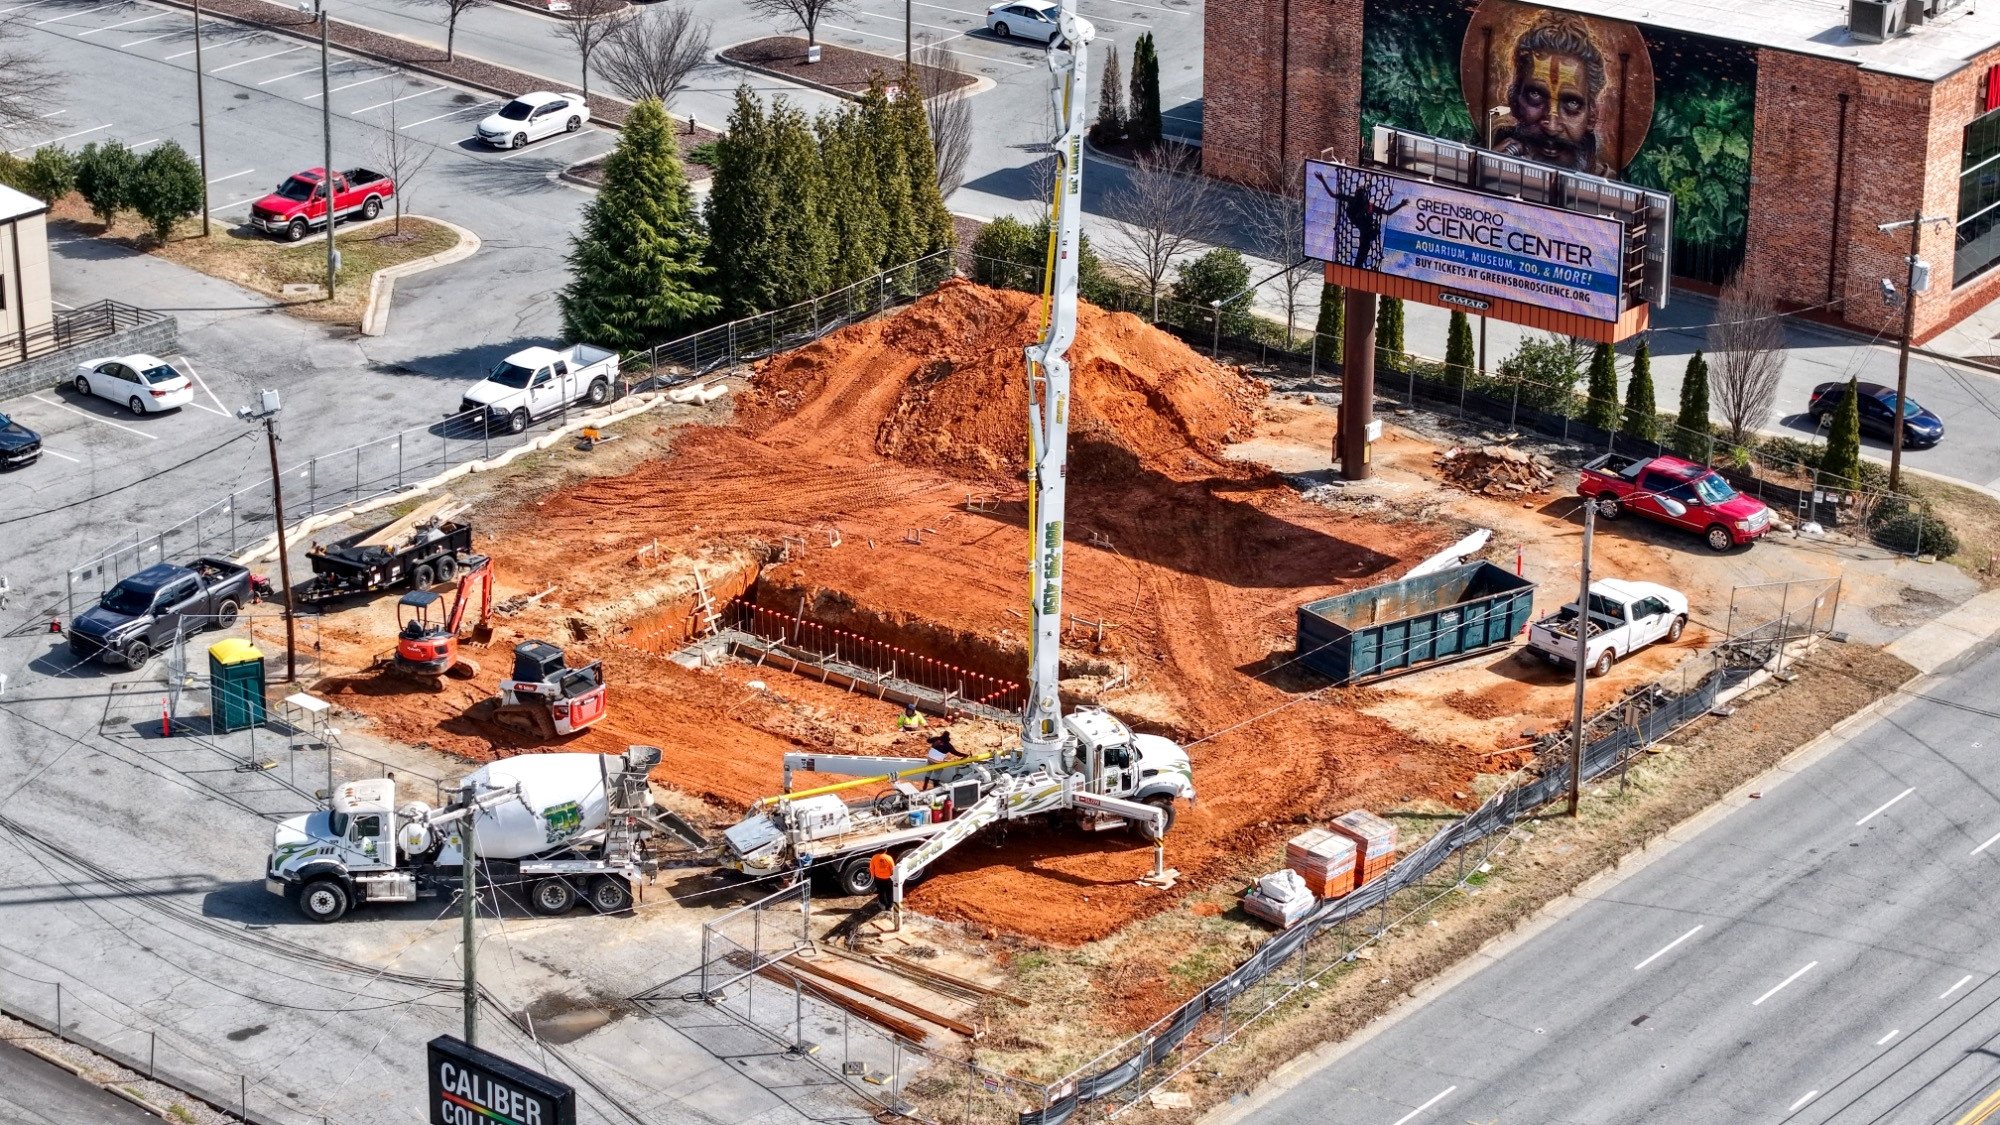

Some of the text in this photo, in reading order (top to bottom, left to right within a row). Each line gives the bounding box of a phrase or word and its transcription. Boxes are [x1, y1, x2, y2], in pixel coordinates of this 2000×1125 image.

[1416, 198, 1504, 227] GREENSBORO
[1415, 212, 1592, 267] SCIENCE CENTER
[1415, 240, 1593, 286] AQUARIUM, MUSEUM, ZOO, & MORE!
[1415, 257, 1591, 303] BUY TICKETS AT GREENSBOROSCIENCE.ORG
[1443, 294, 1484, 309] LAMAR
[441, 1062, 542, 1125] CALIBER
